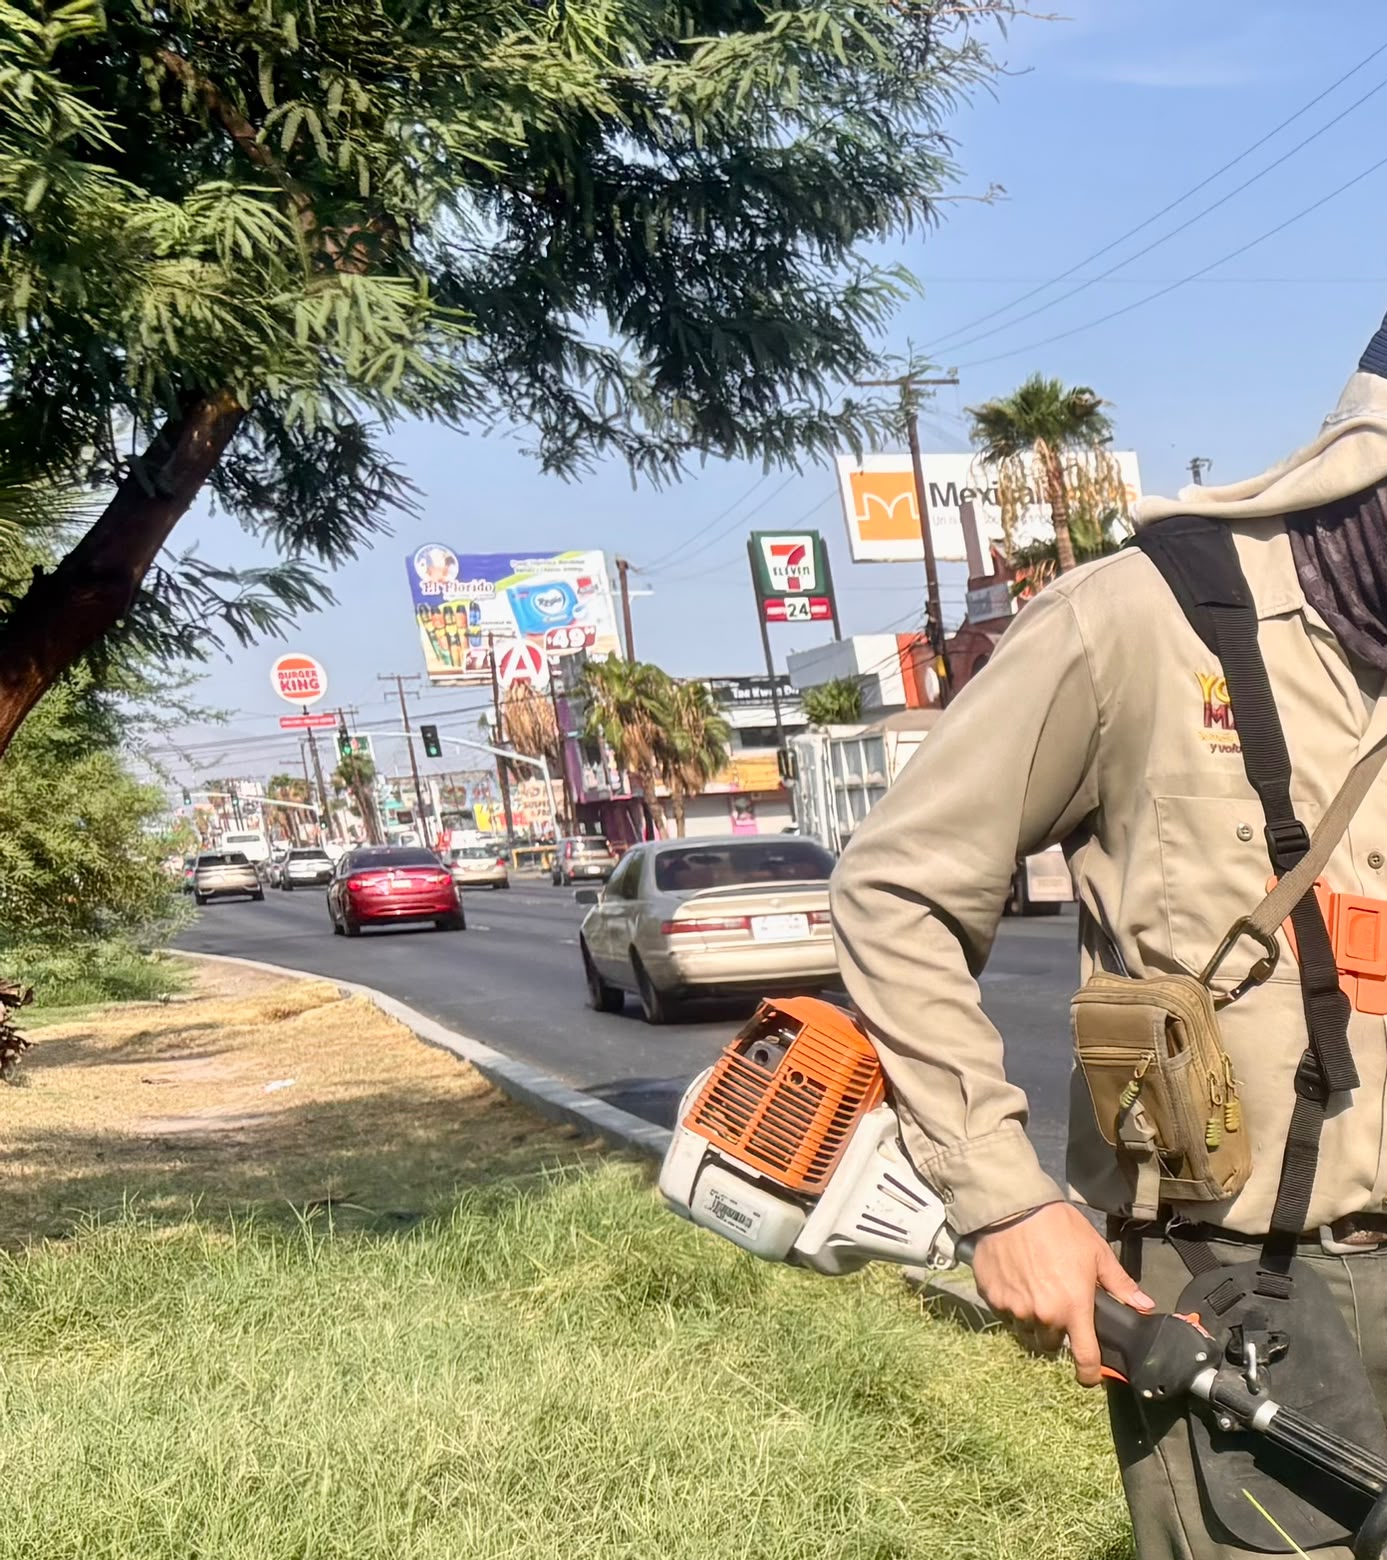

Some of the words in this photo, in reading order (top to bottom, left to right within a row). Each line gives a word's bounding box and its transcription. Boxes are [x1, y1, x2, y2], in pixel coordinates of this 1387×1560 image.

[770, 544, 806, 590] 7
[444, 578, 493, 593] Florido
[787, 603, 808, 617] 24
[278, 670, 317, 679] BURGER
[280, 679, 320, 691] KING
